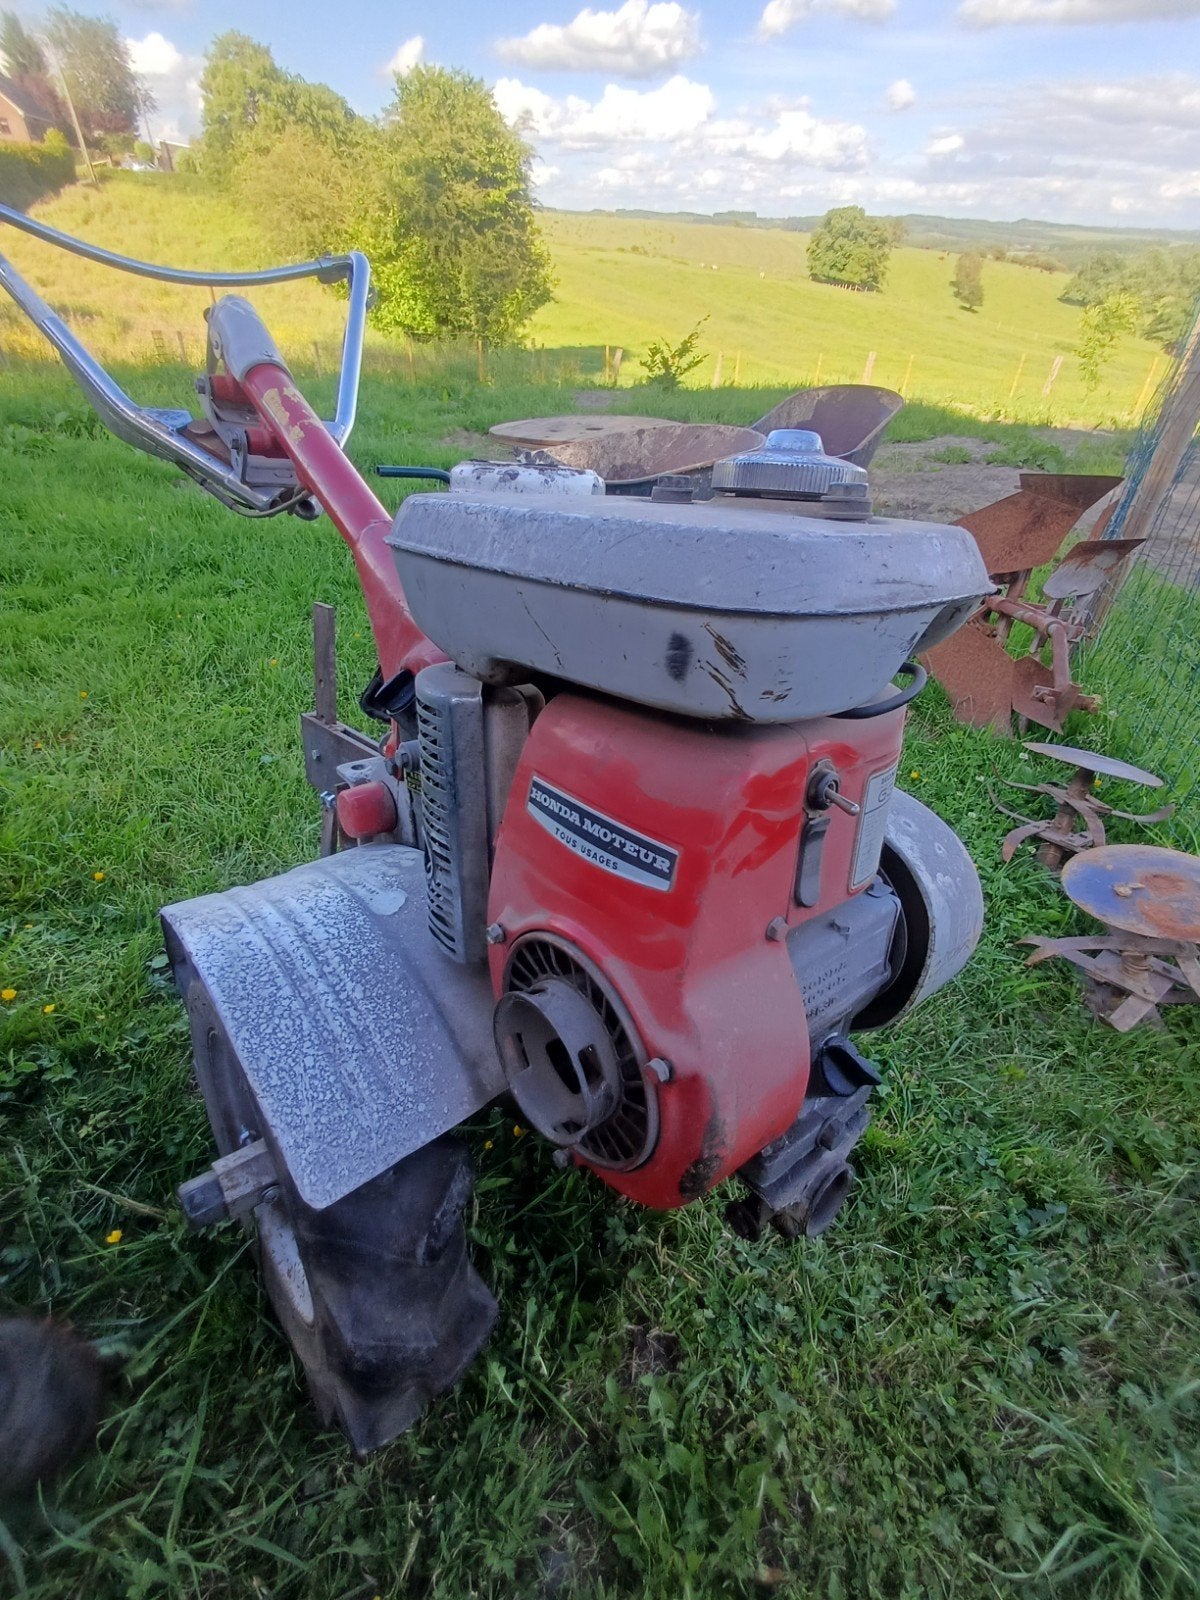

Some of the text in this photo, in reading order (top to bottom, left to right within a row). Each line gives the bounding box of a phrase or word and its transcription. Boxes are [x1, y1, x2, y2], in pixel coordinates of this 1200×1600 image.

[530, 787, 671, 873] HONDA MOTEUR
[554, 827, 619, 871] TOUS USAGES
